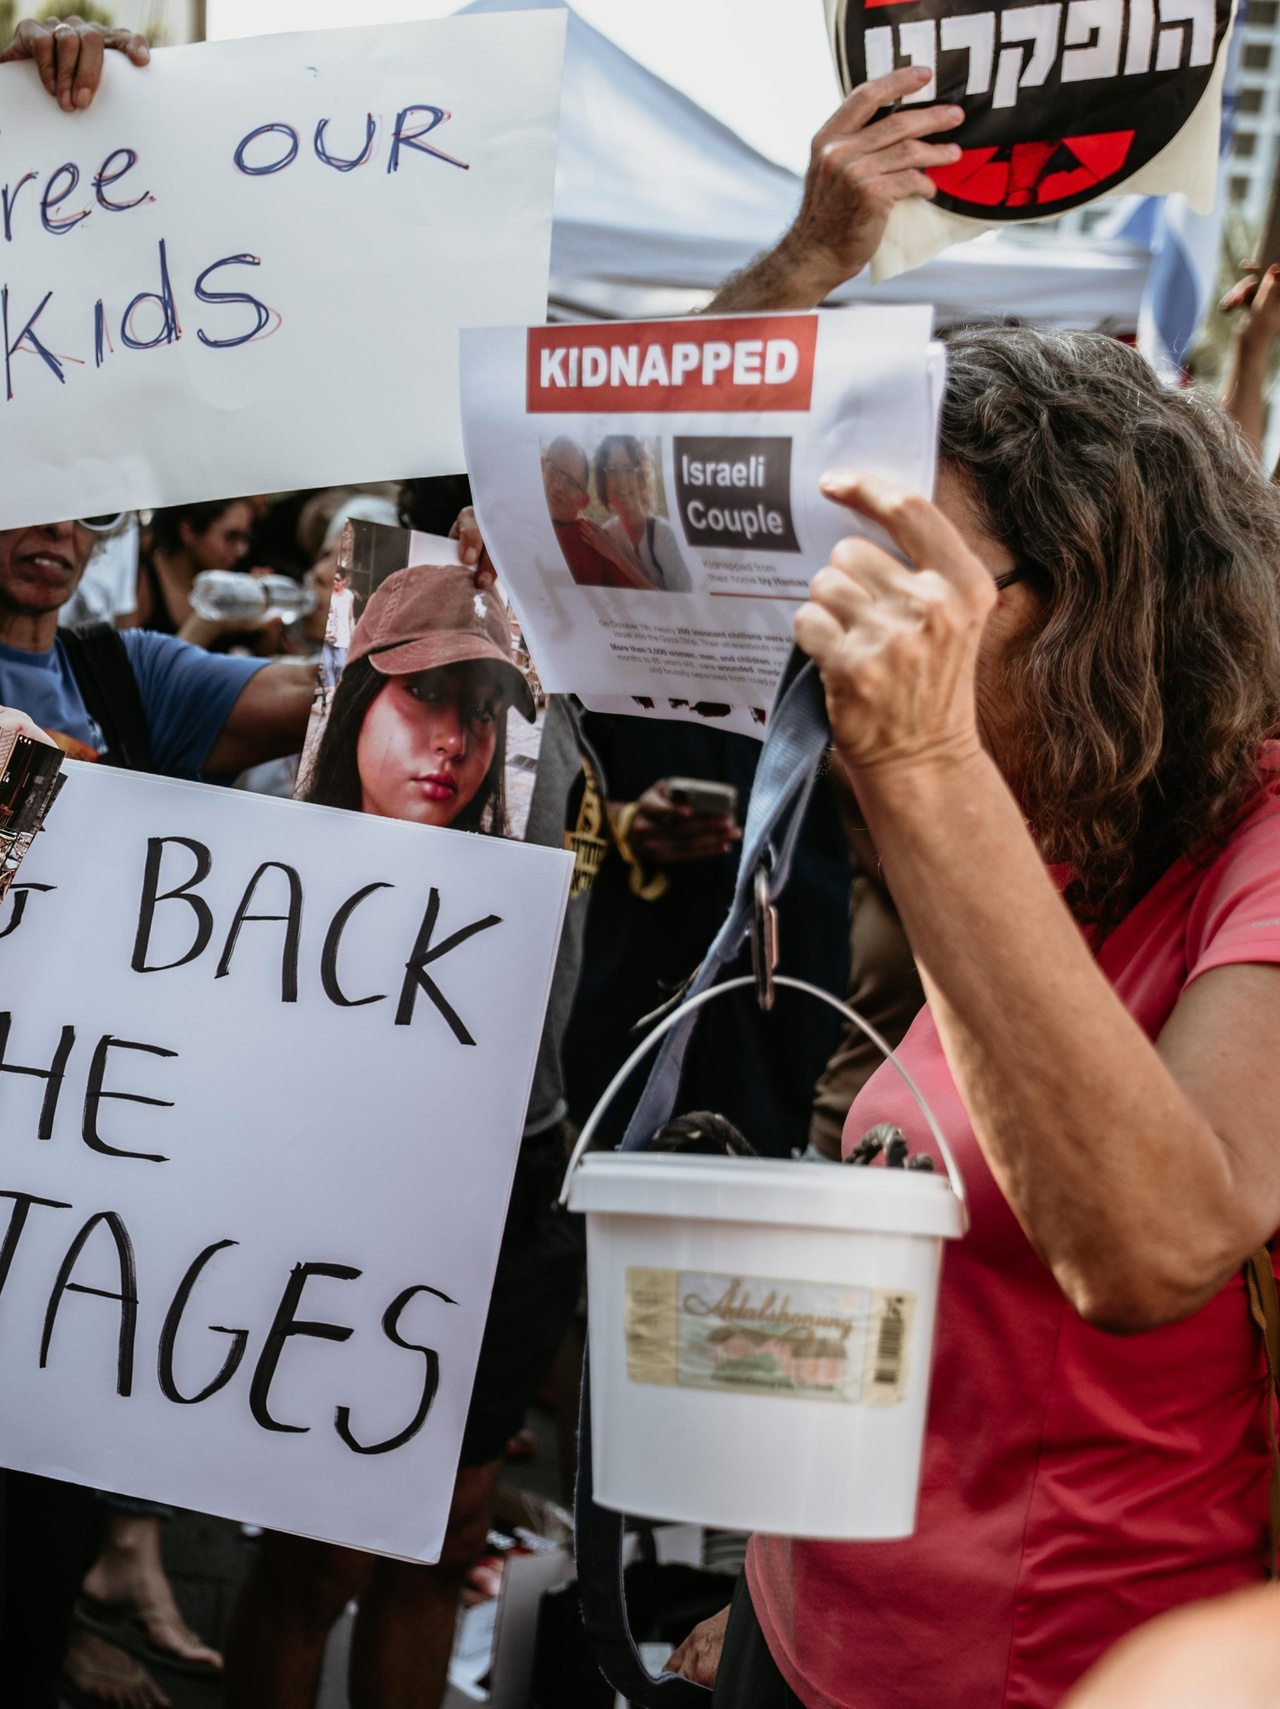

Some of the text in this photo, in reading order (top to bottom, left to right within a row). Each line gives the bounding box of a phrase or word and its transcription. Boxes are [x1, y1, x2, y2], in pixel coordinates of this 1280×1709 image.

[864, 0, 1218, 109] הופקרנו
[232, 104, 470, 175] OUR
[539, 339, 801, 388] KIDNAPPED
[682, 454, 765, 487] Israeli
[686, 500, 785, 540] Couple
[702, 559, 752, 572] Kidnapped
[758, 576, 771, 588] by
[774, 577, 809, 588] Hamas
[131, 836, 503, 1046] BACK
